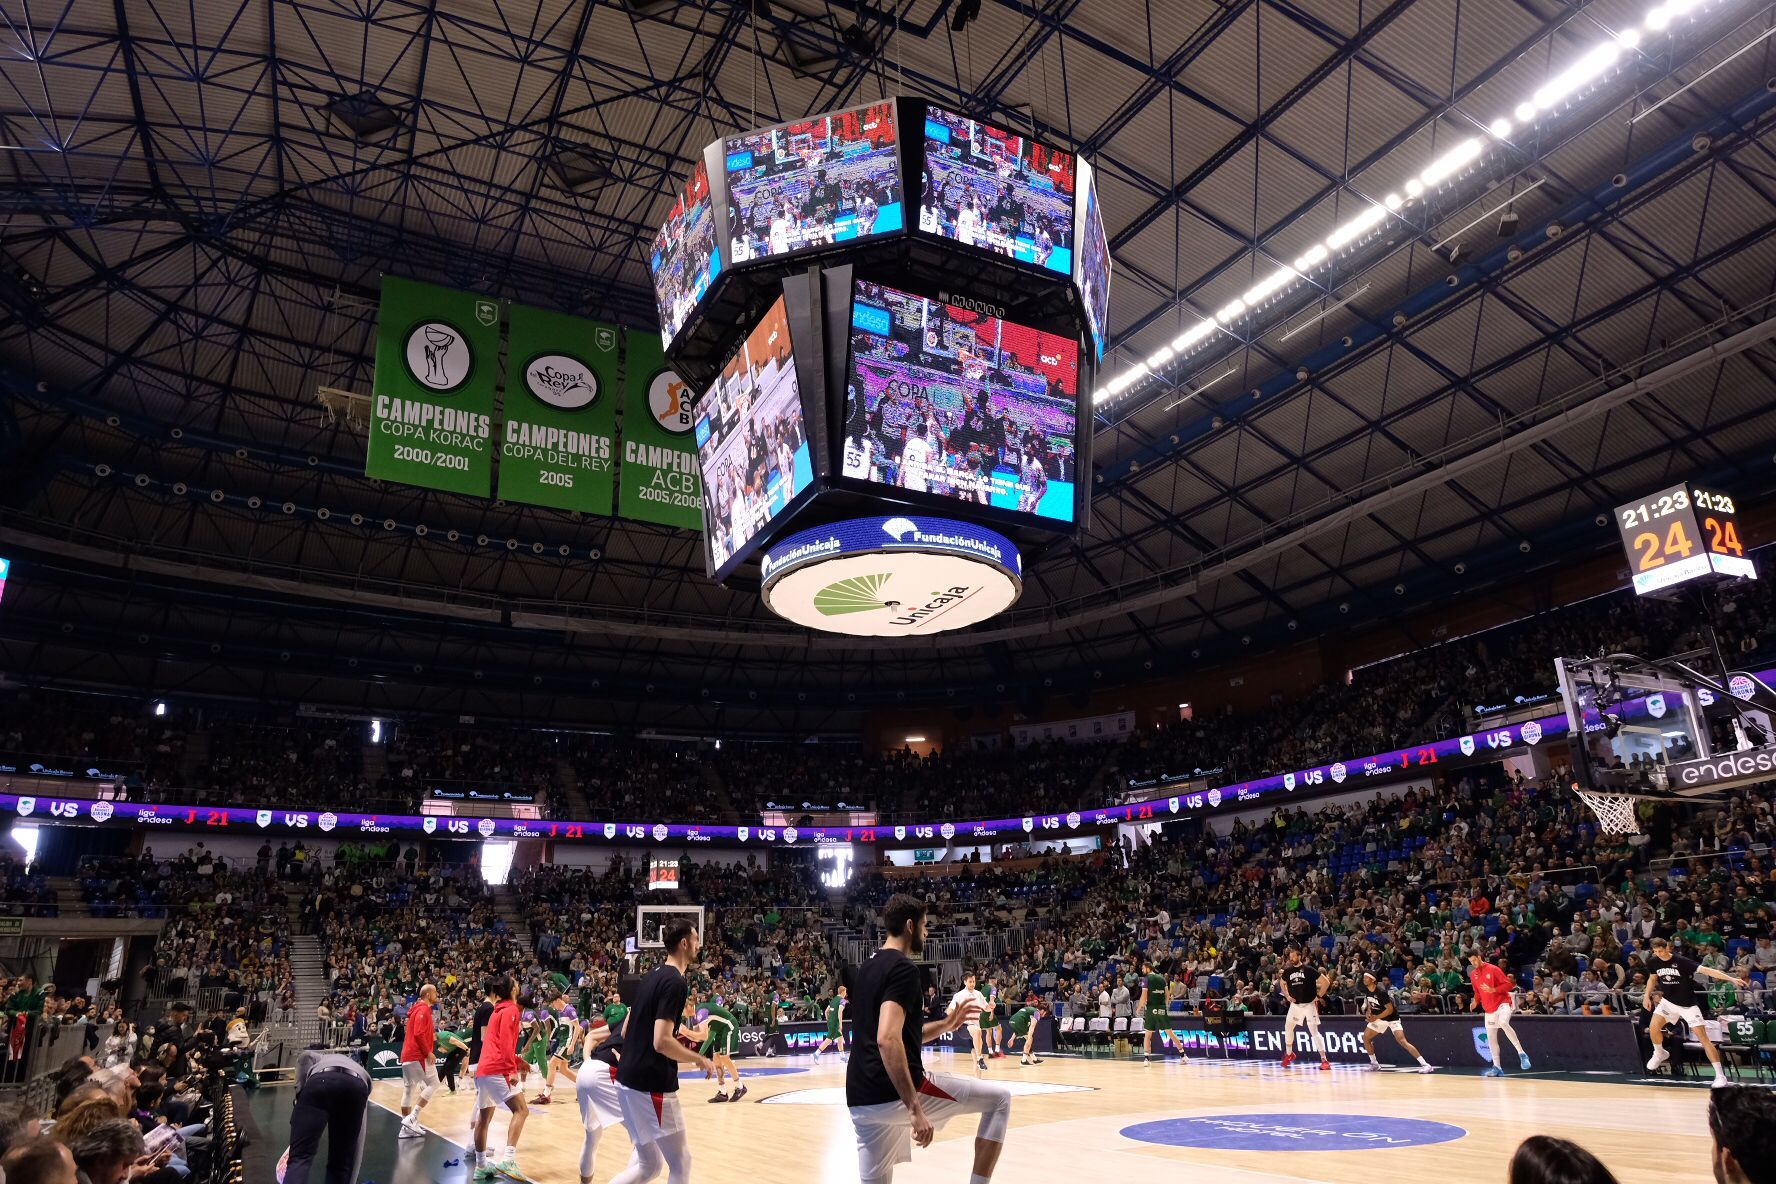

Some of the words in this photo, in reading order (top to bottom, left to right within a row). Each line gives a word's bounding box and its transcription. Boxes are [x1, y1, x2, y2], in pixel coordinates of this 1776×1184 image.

[952, 294, 1005, 318] MONDO
[1041, 355, 1058, 366] acb
[545, 366, 576, 382] Copa
[376, 394, 490, 438] CAMPEONES
[381, 420, 425, 440] COPA
[429, 429, 483, 451] KORAC
[506, 420, 610, 459] CAMPEONES
[394, 444, 469, 471] 2000/2001
[503, 433, 543, 461] COPA
[548, 451, 577, 467] DEL
[582, 456, 611, 472] REY
[539, 470, 573, 488] 2005
[651, 469, 694, 493] ACB
[1622, 490, 1690, 529] 21:23
[1694, 489, 1736, 514] 21:23
[1705, 517, 1743, 557] 24
[1634, 520, 1693, 571] 24
[888, 584, 970, 627] Unicaja
[1487, 731, 1513, 749] VS
[1400, 753, 1409, 769] J
[1418, 748, 1439, 765] 21
[1363, 762, 1377, 770] liga
[1365, 766, 1392, 777] endesa
[1682, 753, 1776, 784] endes
[1304, 770, 1324, 786] VS
[1186, 795, 1203, 809] VS
[1238, 791, 1260, 801] endesa
[50, 801, 79, 818] VS
[138, 808, 155, 817] liga
[184, 809, 197, 824] J
[206, 810, 229, 826] 21
[1124, 808, 1132, 821] J
[1139, 805, 1153, 819] 21
[137, 816, 172, 824] endesa
[285, 814, 309, 828] VS
[448, 820, 470, 834] VS
[1042, 817, 1060, 829] VS
[549, 824, 558, 837] J
[565, 825, 583, 838] 21
[626, 826, 645, 838] VS
[758, 829, 776, 841] VS
[844, 830, 853, 841] J
[860, 829, 876, 841] 21
[915, 827, 933, 838] VS
[660, 869, 676, 881] 24
[1736, 1021, 1754, 1035] 55
[784, 1031, 846, 1048] VEN
[1253, 1030, 1368, 1053] ENRDAS
